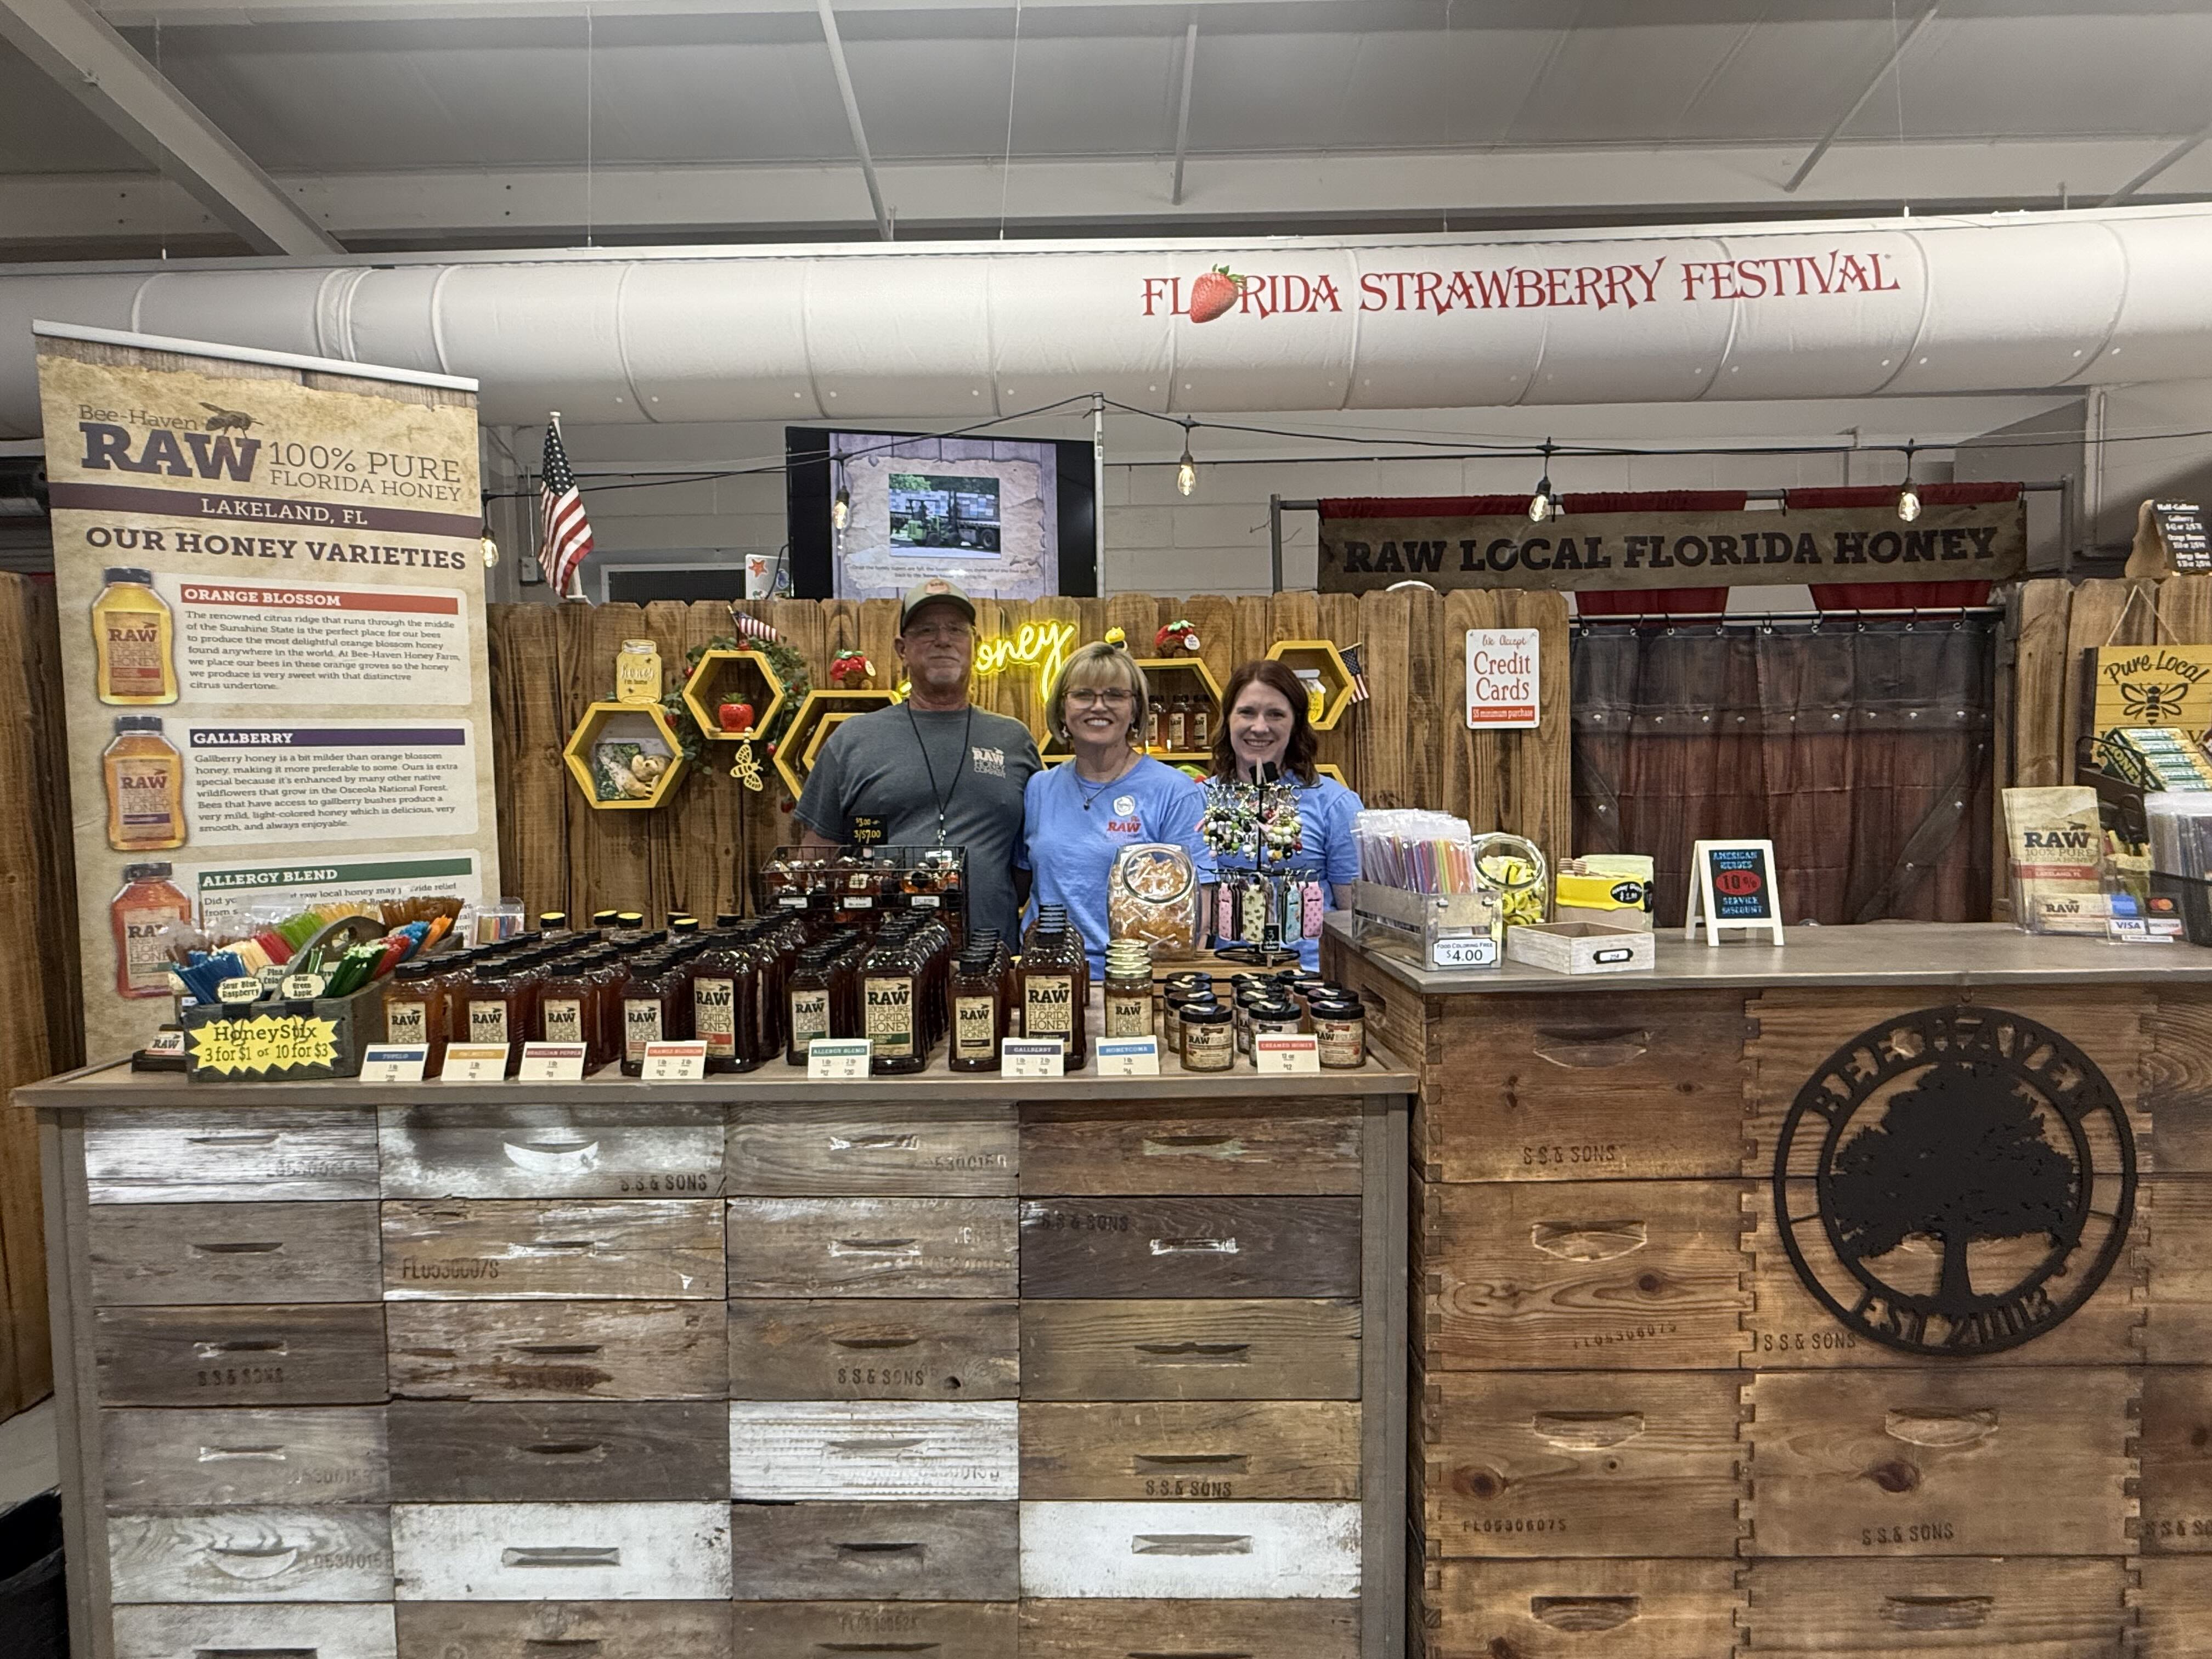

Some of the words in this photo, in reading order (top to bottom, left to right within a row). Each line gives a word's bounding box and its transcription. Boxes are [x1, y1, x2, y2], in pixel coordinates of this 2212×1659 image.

[1360, 256, 1667, 315] STRAWBERRY
[1680, 250, 1900, 301] FESTIVAL
[79, 404, 199, 430] Bee-Haven
[79, 422, 261, 482] RAW
[269, 442, 356, 472] 100%
[367, 452, 460, 483] PURE
[270, 470, 375, 494] FLORIDA
[381, 479, 461, 501] HONEY
[202, 498, 334, 524] LAKELAND,
[343, 509, 368, 524] FL
[87, 527, 166, 551] OUR
[176, 532, 295, 559] HONEY
[308, 541, 466, 571] VARIETIES
[1343, 540, 1447, 573] RAW
[1460, 537, 1611, 571] LOCAL
[1624, 532, 1821, 568] FLORIDA
[1833, 527, 1997, 564] HONEY
[185, 589, 258, 602] ORANGE
[263, 592, 341, 606] BLOSSOM
[185, 611, 206, 619] The
[295, 616, 320, 624] ridge
[368, 619, 405, 627] through
[108, 629, 157, 641] RAW
[326, 628, 358, 636] perfect
[1474, 651, 1531, 675] Credit
[2104, 654, 2152, 684] Pure
[2156, 650, 2209, 684] Local
[1476, 677, 1529, 701] Cards
[1508, 708, 1533, 719] purchase
[194, 733, 294, 744] GALLBERRY
[972, 750, 1004, 764] RAW
[121, 776, 167, 788] RAW
[197, 778, 232, 787] special
[1107, 821, 1141, 832] RAW
[2024, 832, 2090, 848] RAW
[202, 873, 283, 888] ALLERGY
[283, 870, 338, 882] BLEND
[319, 889, 342, 898] local
[344, 889, 374, 898] honey
[2046, 904, 2079, 913] RAW
[1447, 949, 1483, 961] $4.00
[222, 989, 259, 997] Raspberry
[696, 991, 731, 1006] RAW
[868, 991, 910, 1005] RAW
[1028, 990, 1070, 1003] RAW
[796, 1003, 824, 1013] RAW
[960, 1010, 989, 1019] RAW
[1116, 1006, 1141, 1015] RAW
[392, 1015, 421, 1025] RAW
[472, 1014, 501, 1024] RAW
[549, 1013, 575, 1022] RAW
[629, 1013, 656, 1023] RAW
[868, 1013, 910, 1022] FLORIDA
[868, 1022, 909, 1032] HONEY
[1029, 1020, 1070, 1030] HONEY
[214, 1024, 317, 1043] HoneyStix
[1188, 1035, 1210, 1044] RAW
[206, 1047, 212, 1062] 3
[216, 1047, 235, 1061] for
[239, 1047, 251, 1061] $1
[257, 1048, 269, 1057] or
[276, 1045, 289, 1059] 10
[292, 1044, 311, 1058] for
[314, 1042, 328, 1058] $3
[665, 1173, 707, 1190] SONS
[883, 1369, 924, 1385] SONS
[1190, 1481, 1232, 1497] SONS
[1910, 1522, 1954, 1542] SONS
